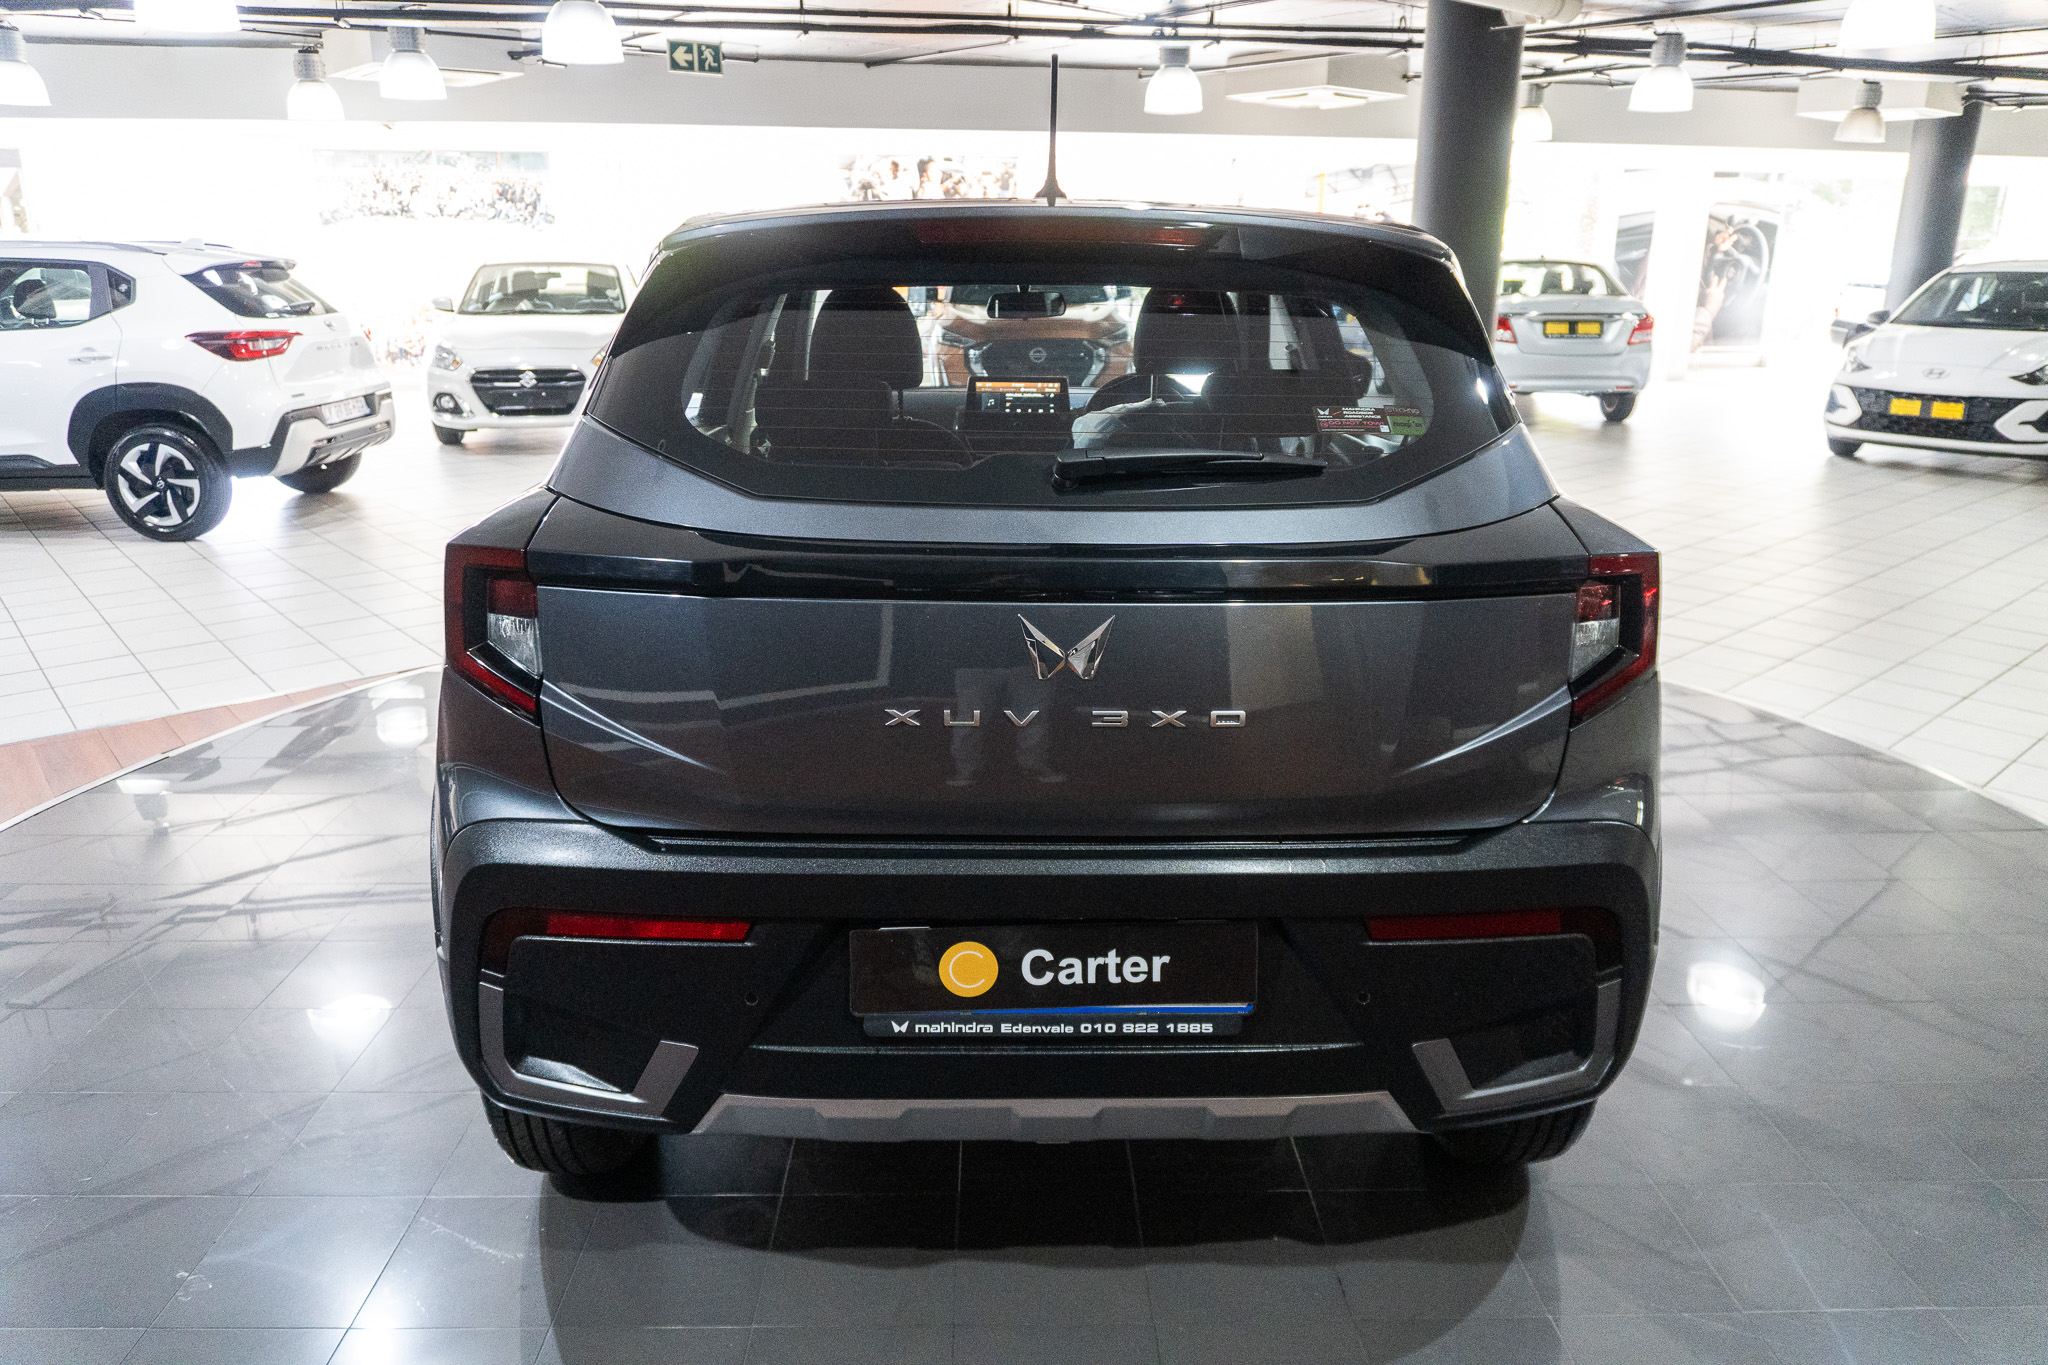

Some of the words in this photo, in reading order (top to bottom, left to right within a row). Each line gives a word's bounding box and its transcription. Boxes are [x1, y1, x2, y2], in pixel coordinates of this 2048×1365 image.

[884, 708, 1040, 728] XUV
[1091, 709, 1247, 729] 3XO
[1021, 947, 1172, 987] Carter
[914, 1021, 994, 1034] mahindra
[1000, 1022, 1074, 1035] Edenvale
[1079, 1022, 1117, 1034] 010
[1122, 1022, 1159, 1034] 822
[1165, 1022, 1214, 1034] 1885
